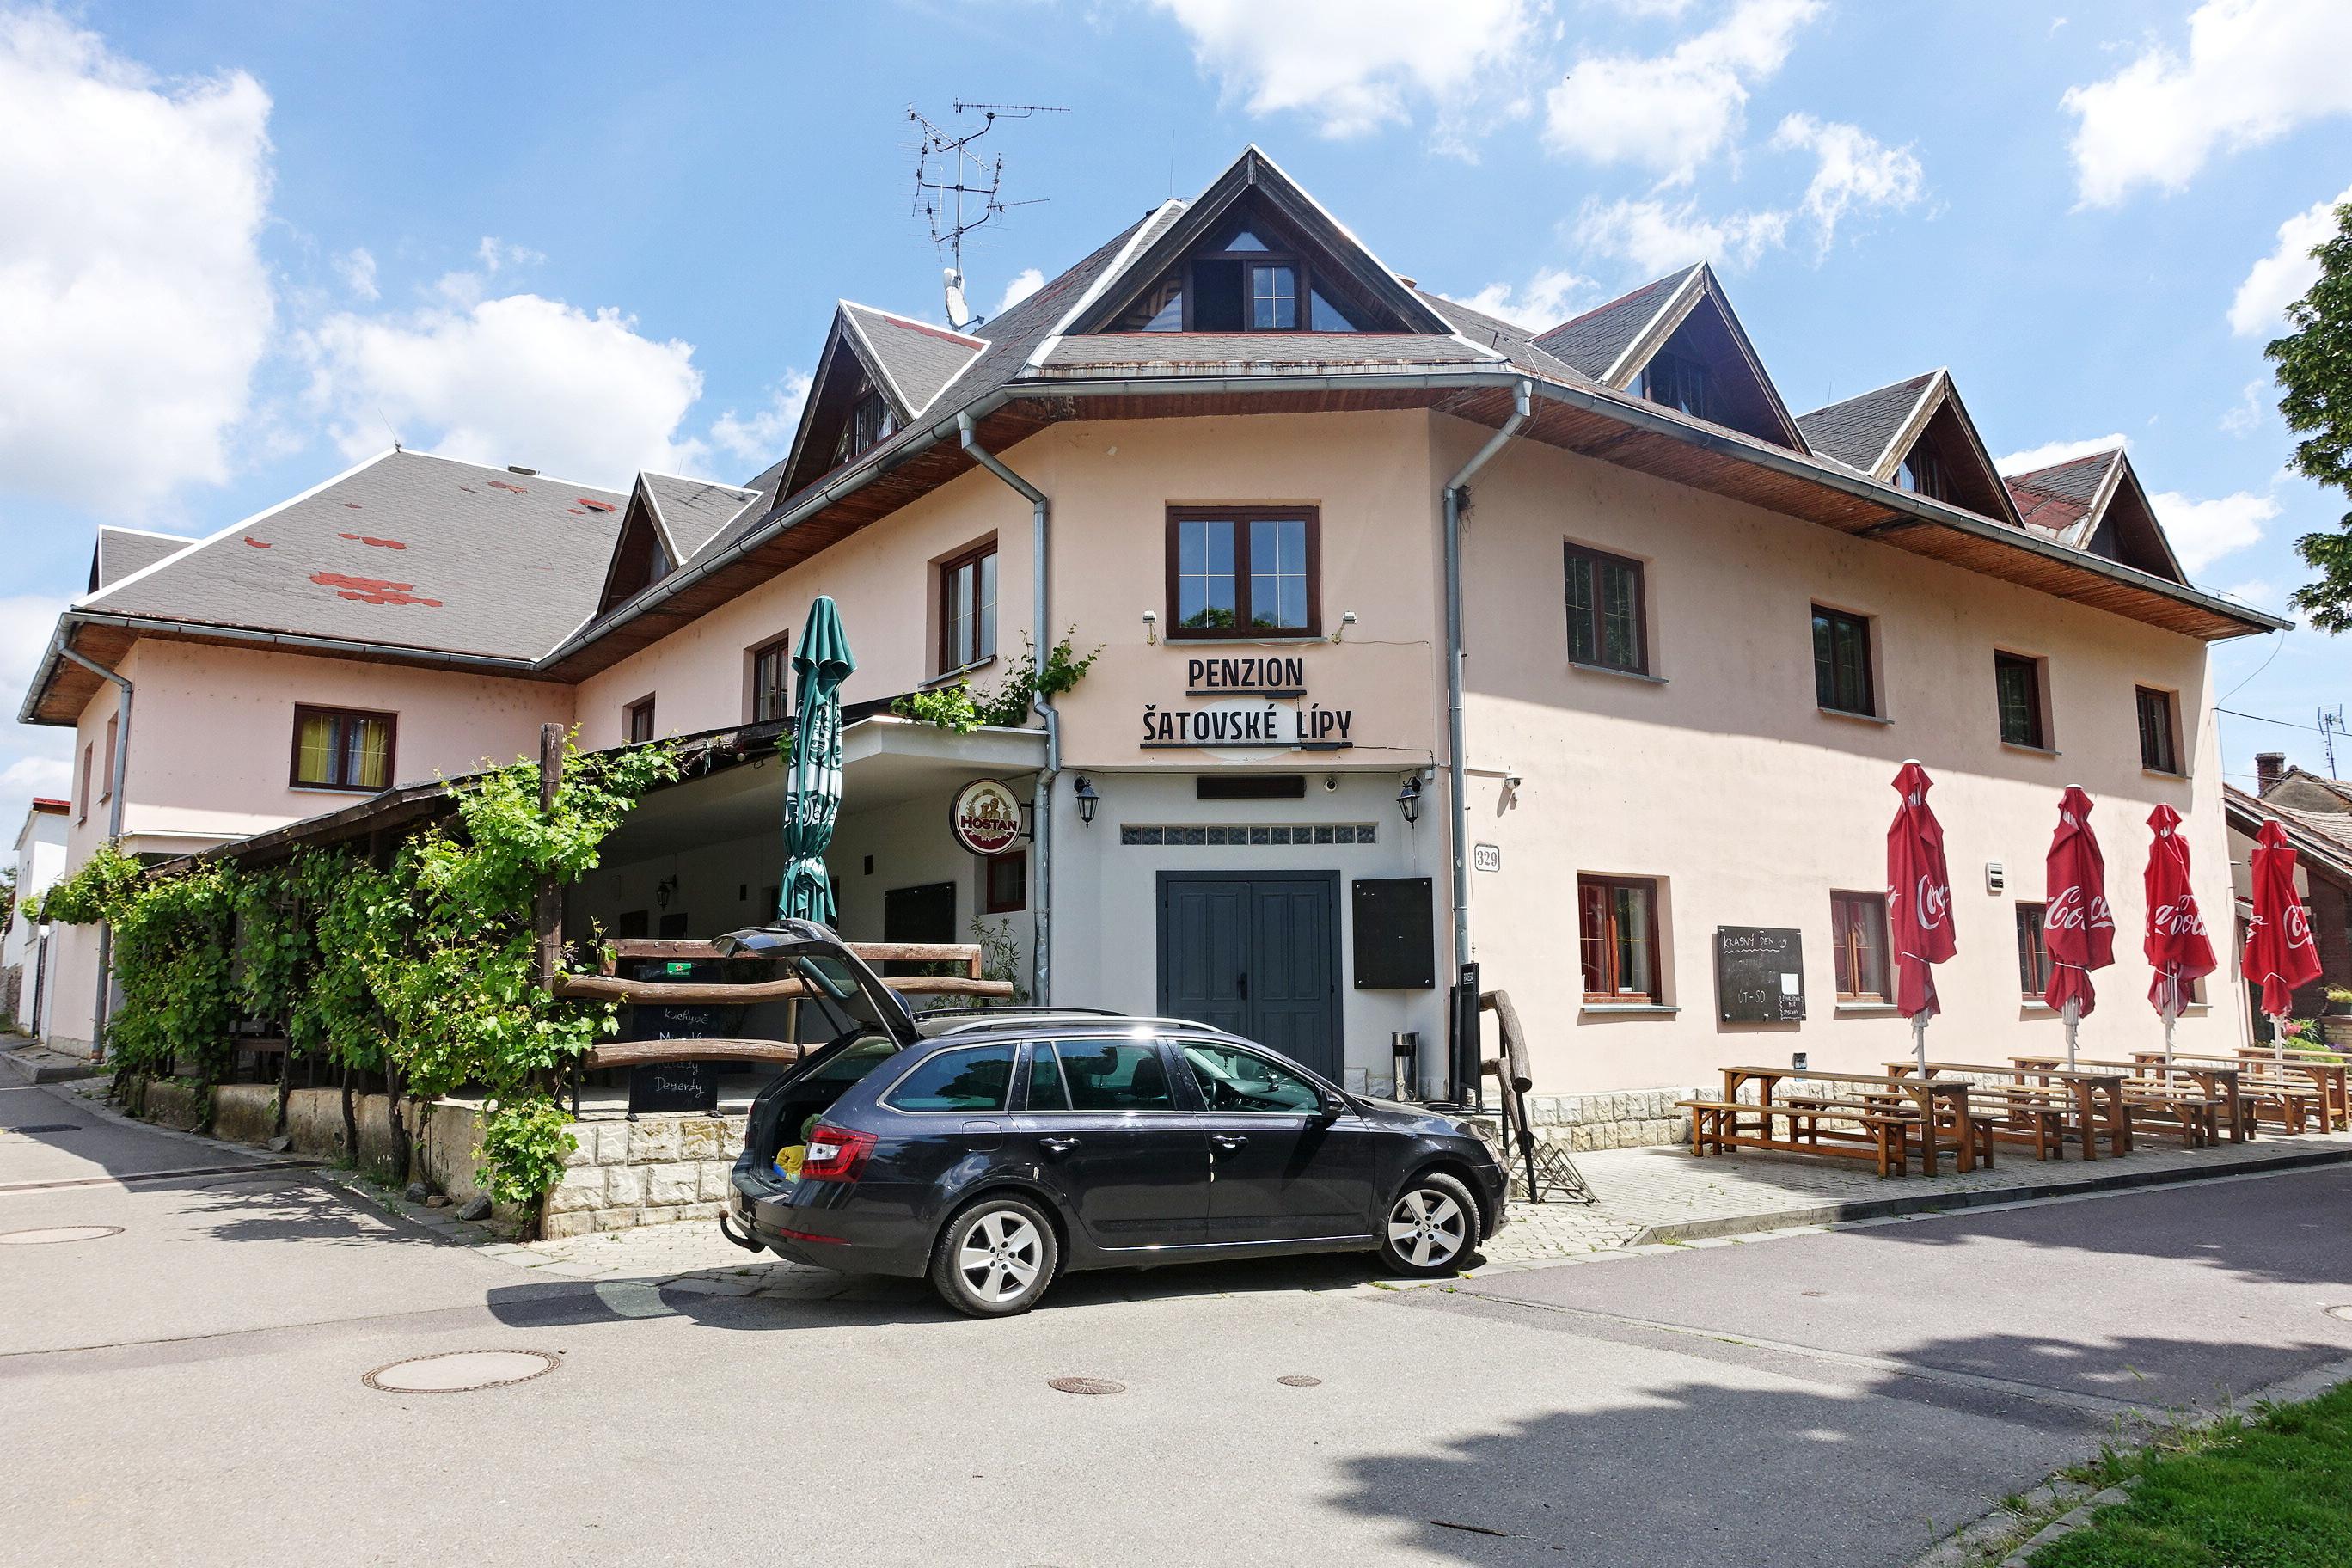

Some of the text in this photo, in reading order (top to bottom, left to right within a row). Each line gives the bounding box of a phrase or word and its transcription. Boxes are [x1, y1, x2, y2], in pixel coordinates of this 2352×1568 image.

[1188, 658, 1303, 688] PENZION
[1142, 702, 1352, 741] ŠATOVSKÉ LÍPY
[960, 815, 1018, 831] HOSTAN
[1477, 850, 1498, 867] 329
[1760, 937, 1774, 946] DEN
